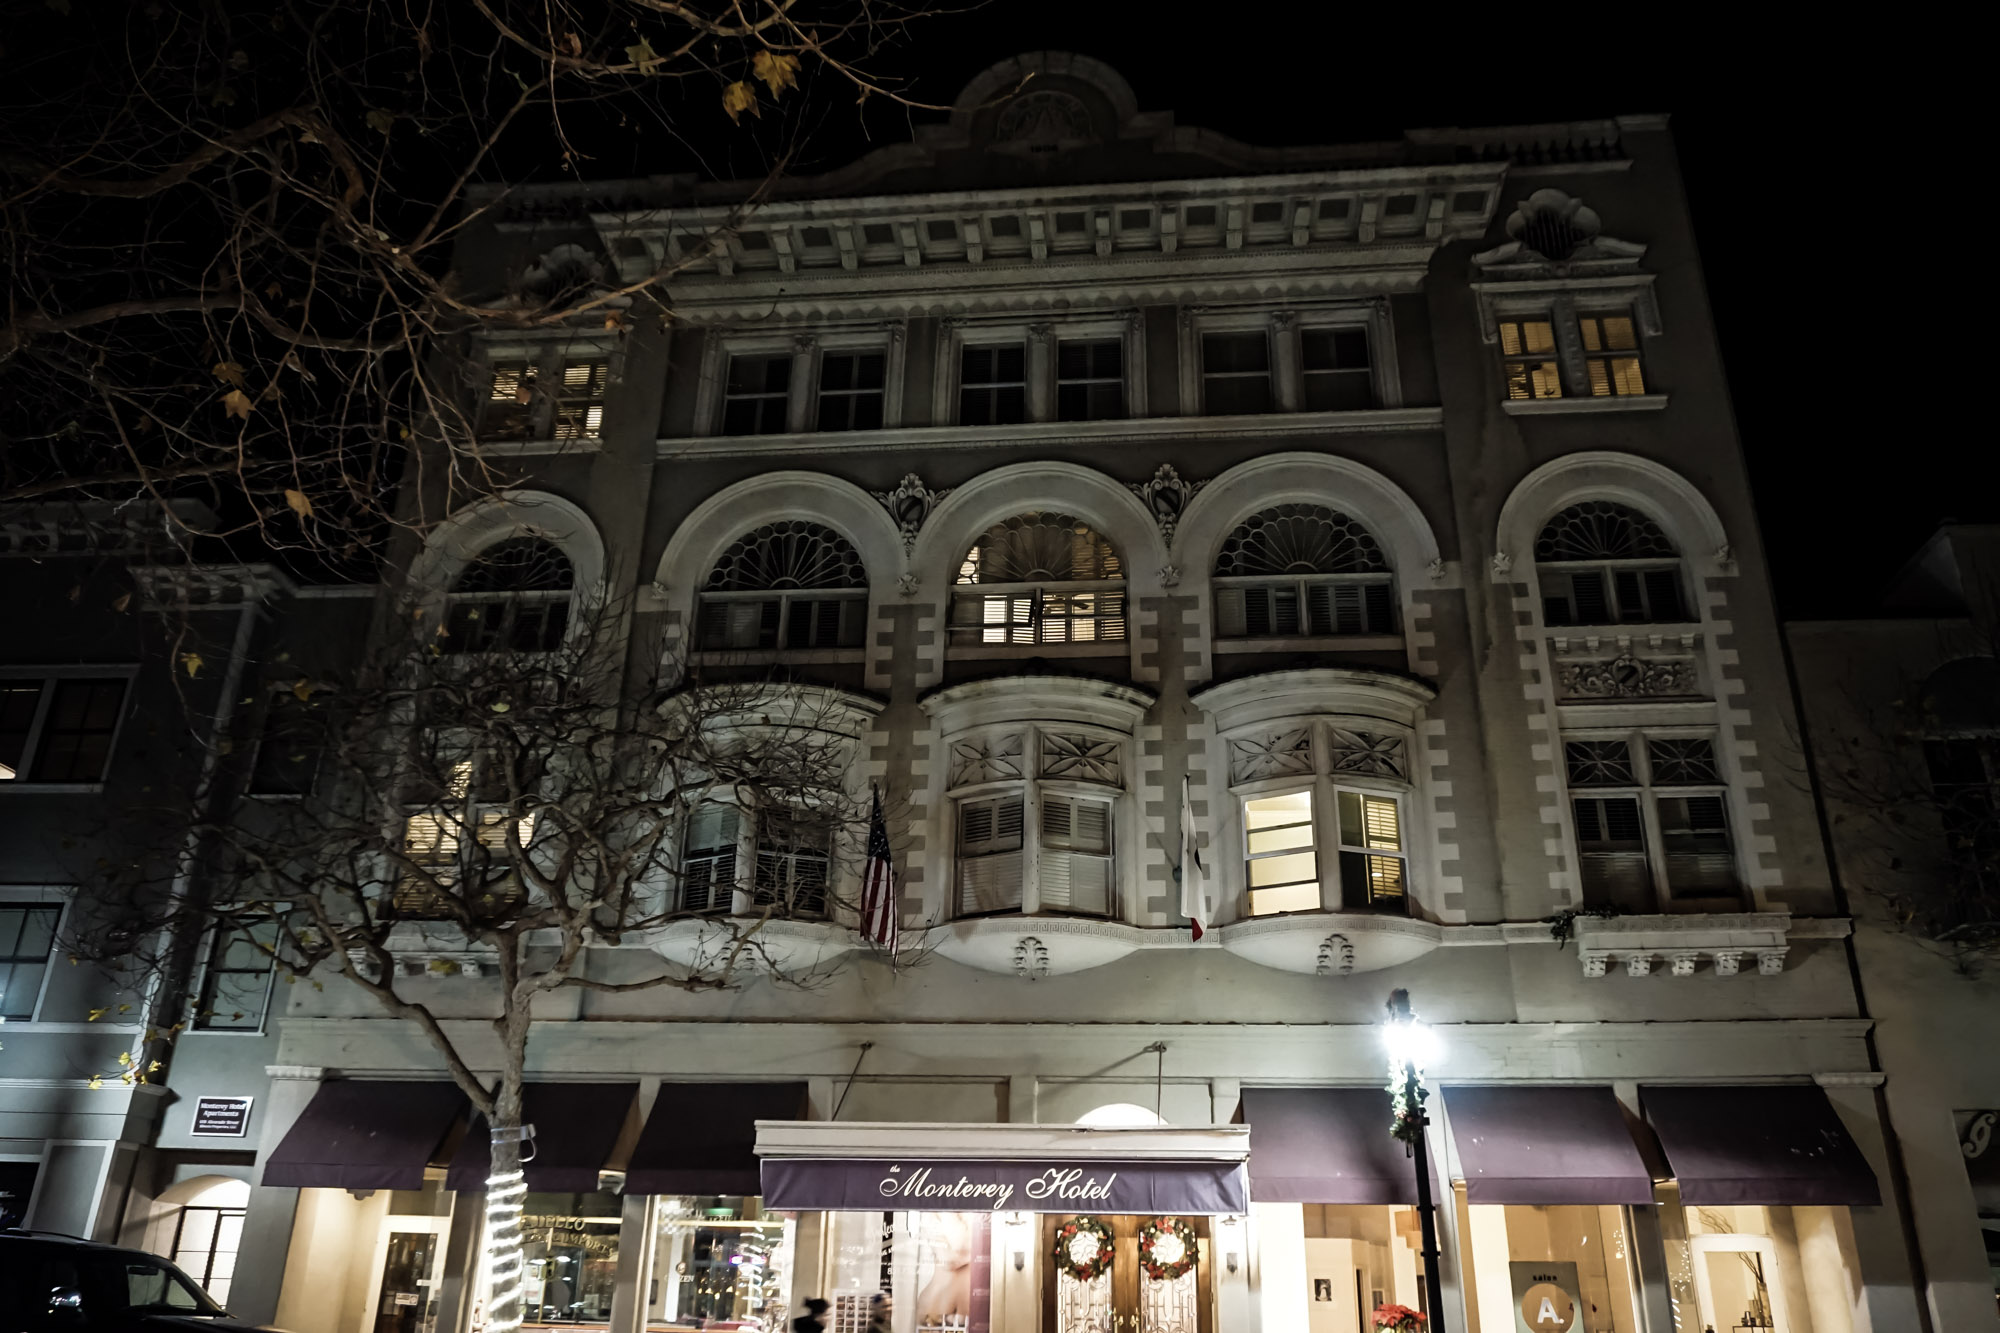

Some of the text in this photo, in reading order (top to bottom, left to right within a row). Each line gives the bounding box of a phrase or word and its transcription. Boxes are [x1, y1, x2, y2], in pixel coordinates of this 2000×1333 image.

[200, 1103, 228, 1111] Monterey
[203, 1110, 239, 1118] Apartments
[889, 1164, 900, 1173] the
[879, 1167, 1117, 1210] Monterey Hotel
[563, 1232, 615, 1257] IMPORTS
